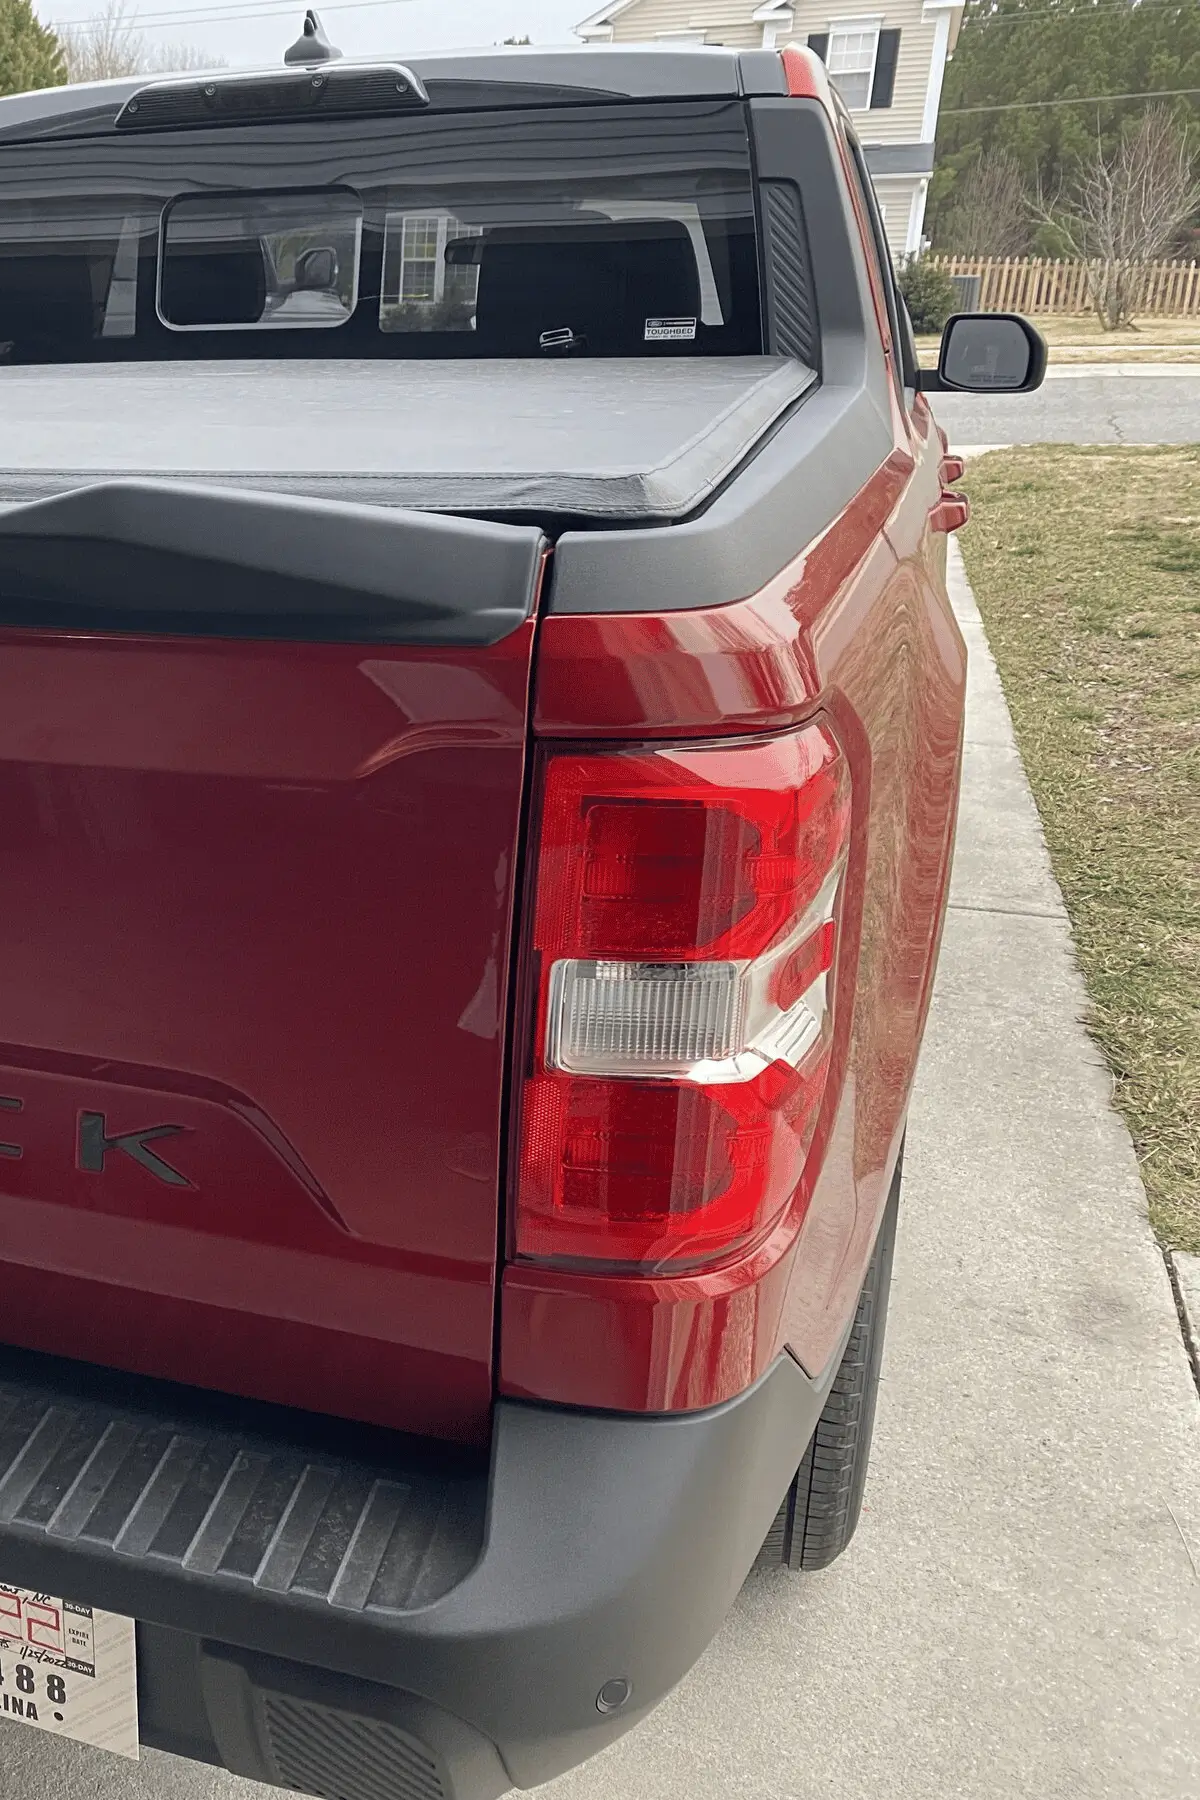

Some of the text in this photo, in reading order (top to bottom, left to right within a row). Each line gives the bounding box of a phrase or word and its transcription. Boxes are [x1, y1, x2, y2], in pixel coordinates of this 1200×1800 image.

[32, 1592, 52, 1607] NC
[63, 1601, 91, 1615] 30-DAY
[68, 1627, 89, 1640] EXPIRE
[71, 1637, 87, 1648] DATE
[66, 1660, 93, 1673] 30-DAY
